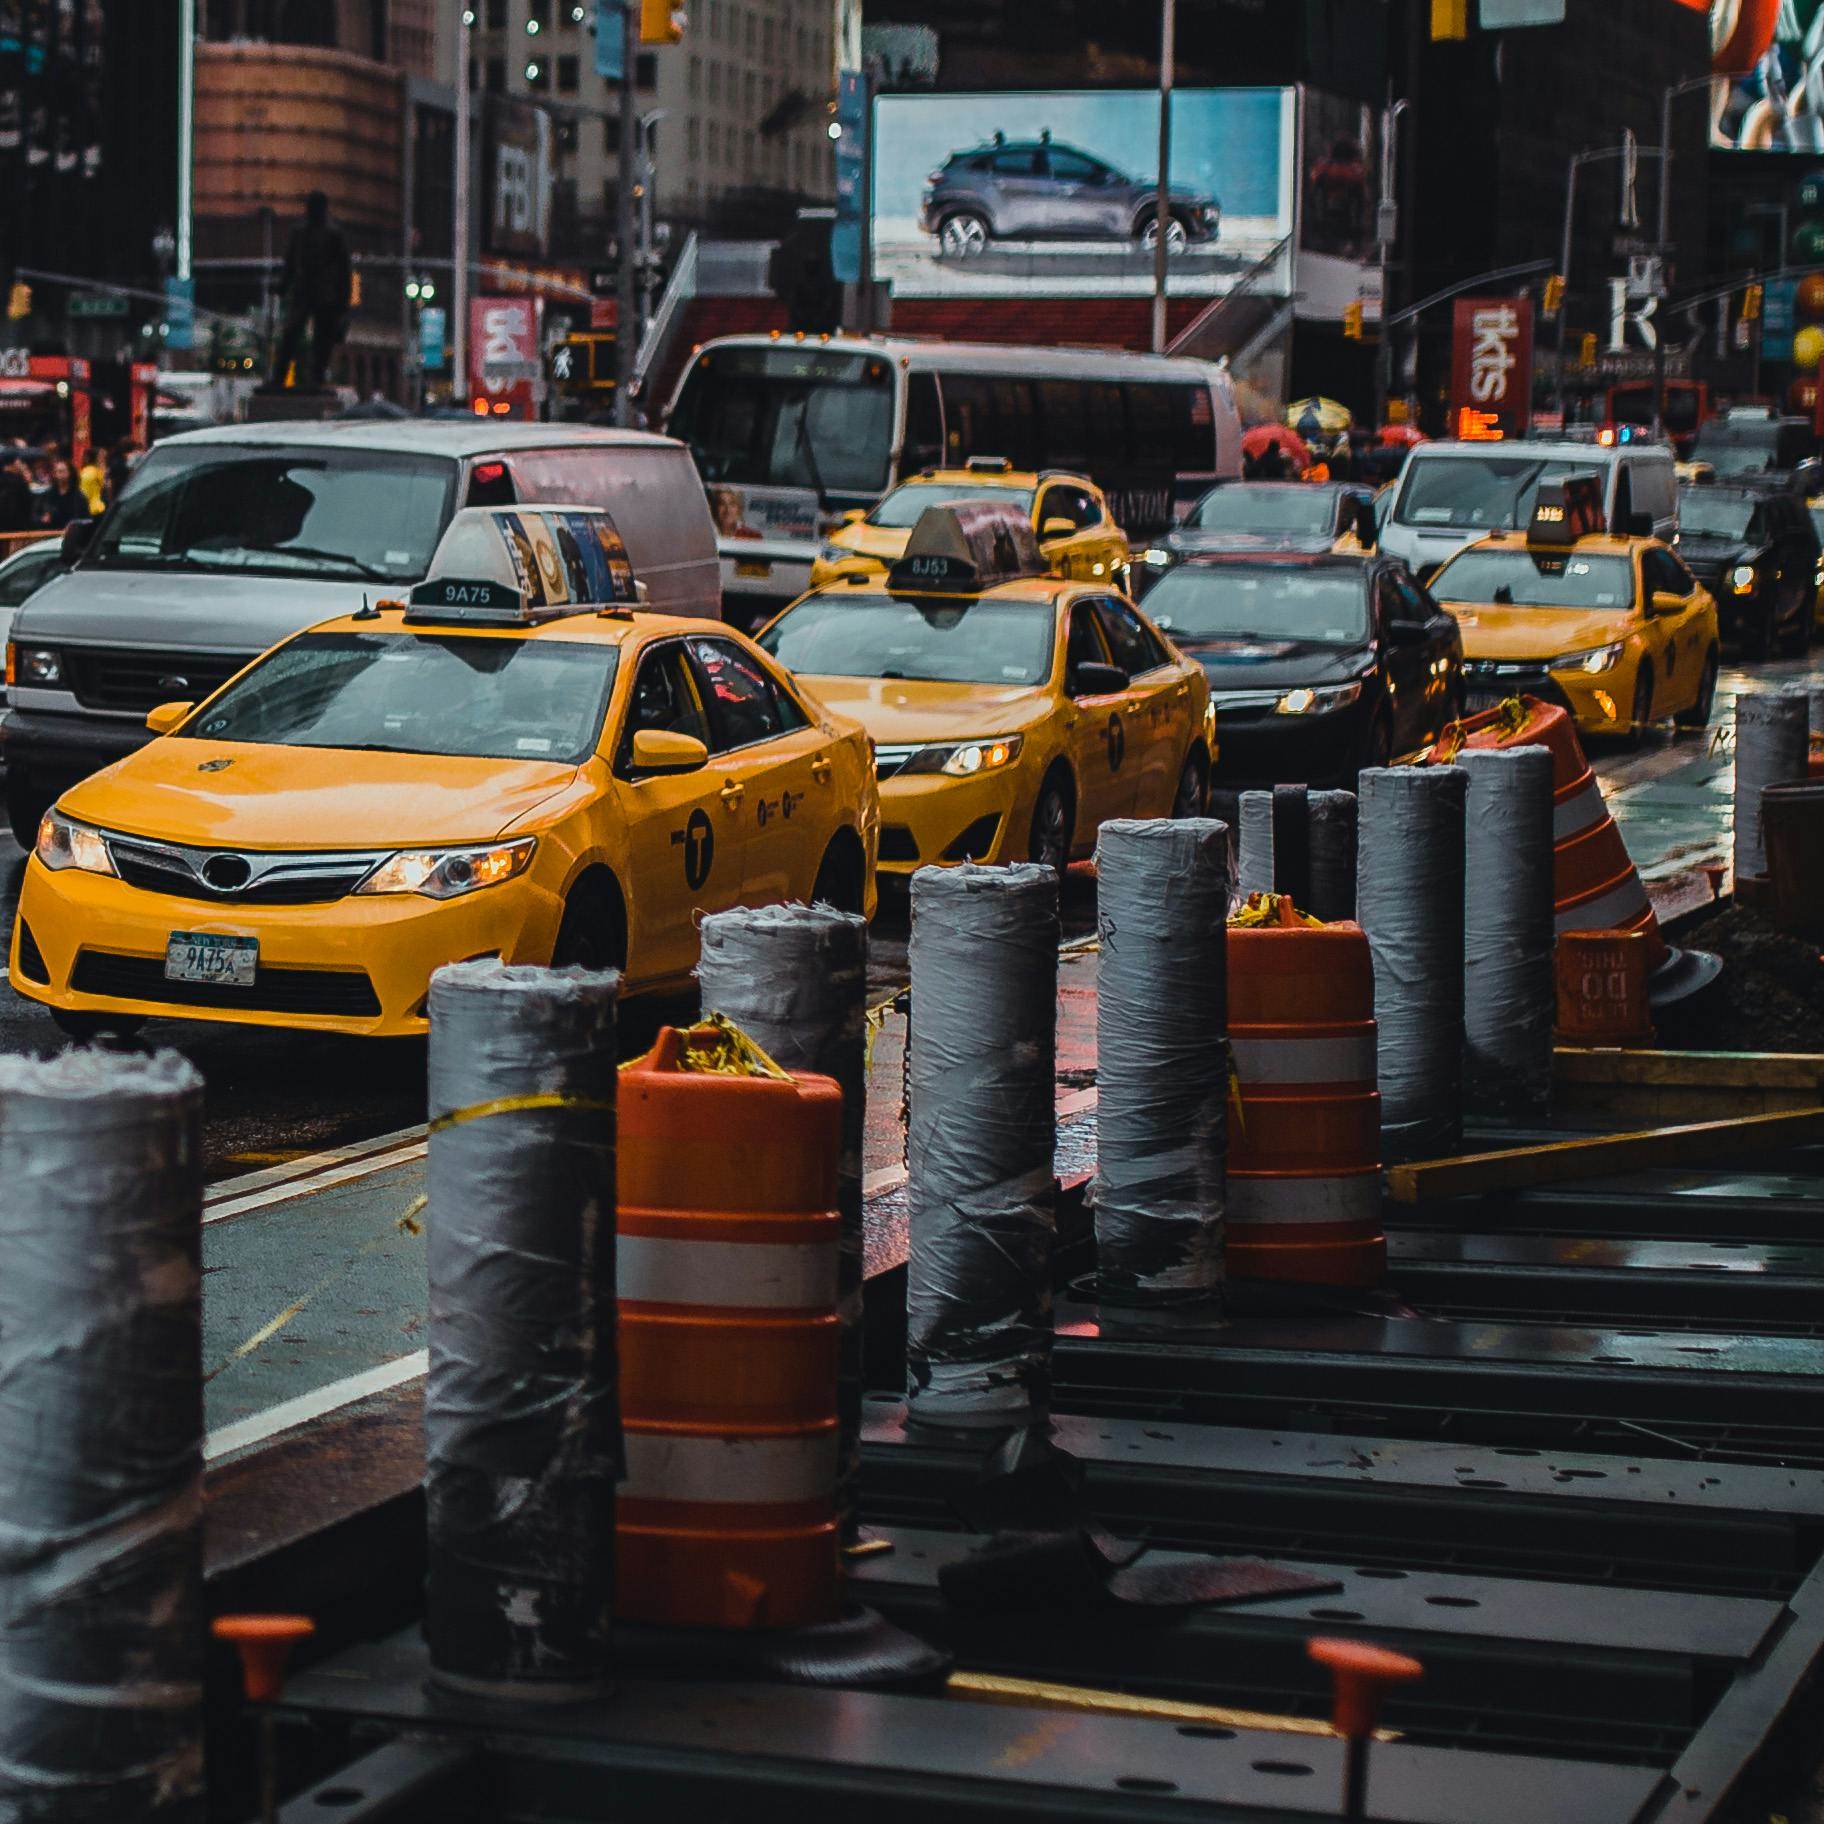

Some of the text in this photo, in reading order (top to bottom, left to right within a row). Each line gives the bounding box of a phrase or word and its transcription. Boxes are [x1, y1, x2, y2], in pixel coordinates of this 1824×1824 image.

[1471, 304, 1519, 403] tkts
[445, 585, 491, 604] 9A75
[691, 826, 707, 879] T
